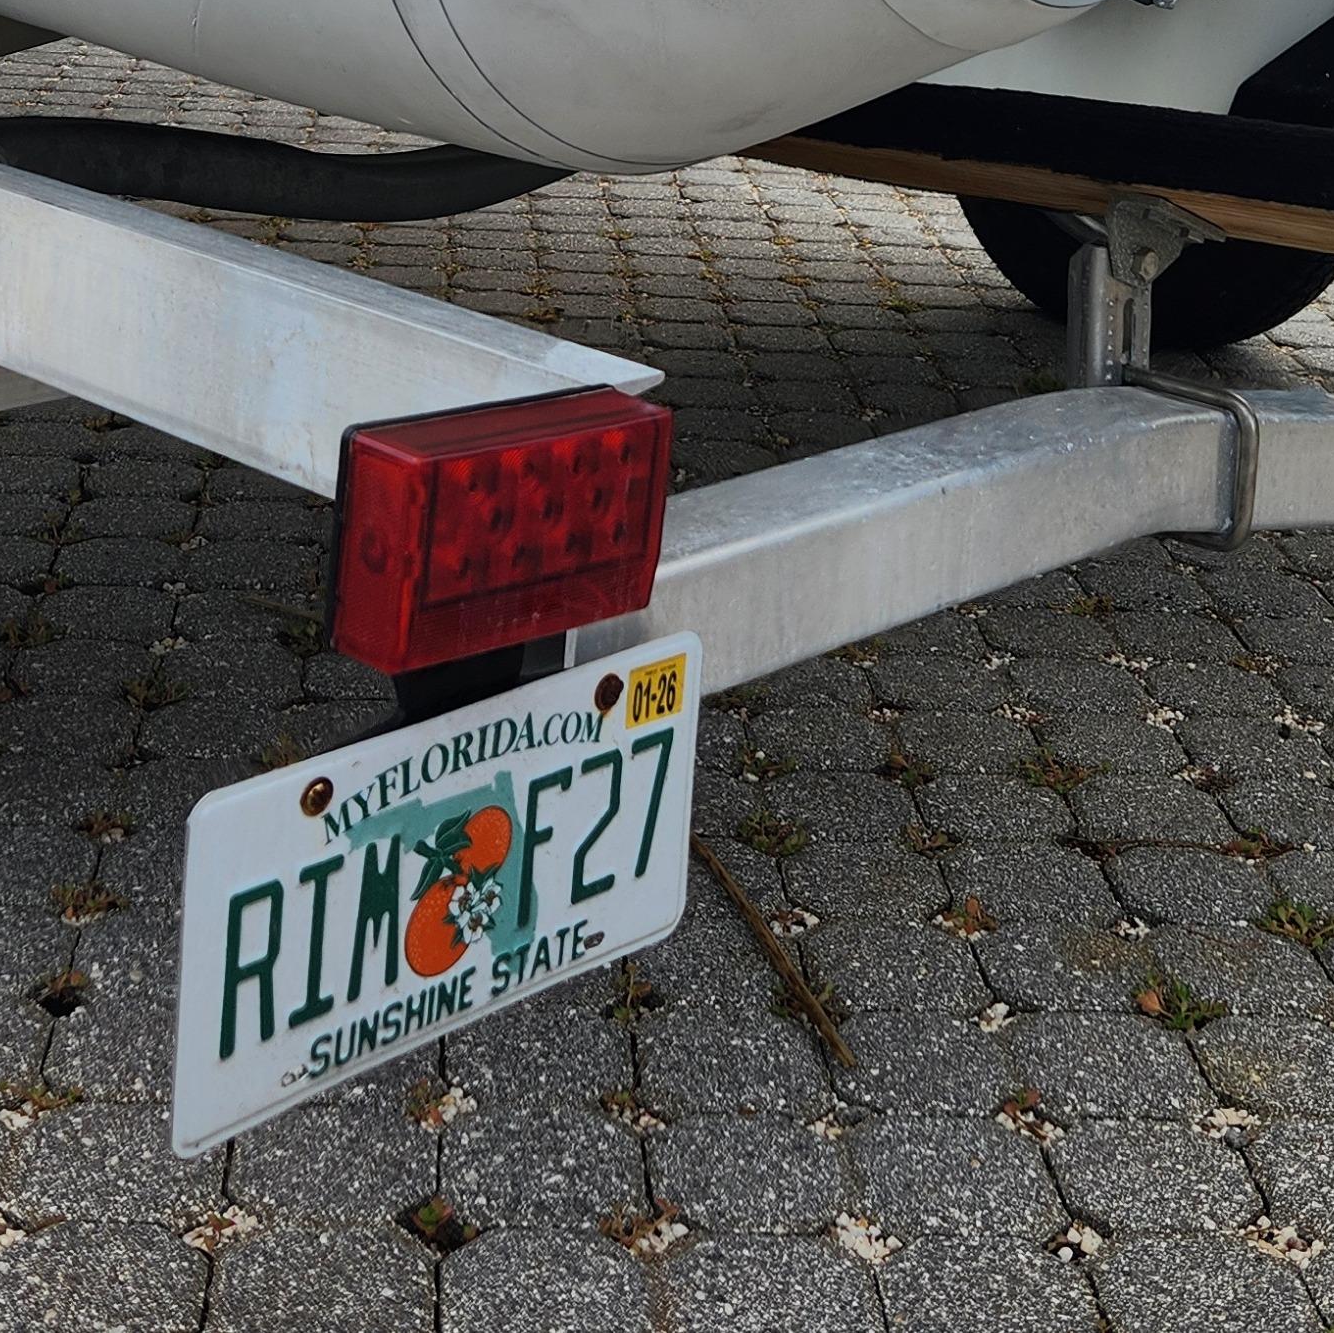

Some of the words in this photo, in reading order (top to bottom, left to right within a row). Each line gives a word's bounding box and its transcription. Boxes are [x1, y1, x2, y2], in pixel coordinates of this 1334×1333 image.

[632, 669, 678, 723] 01-26
[320, 710, 607, 846] MYFLORIDA.COM
[515, 726, 675, 929] F27
[308, 966, 477, 1078] SUNSHINE
[490, 919, 589, 997] STATE
